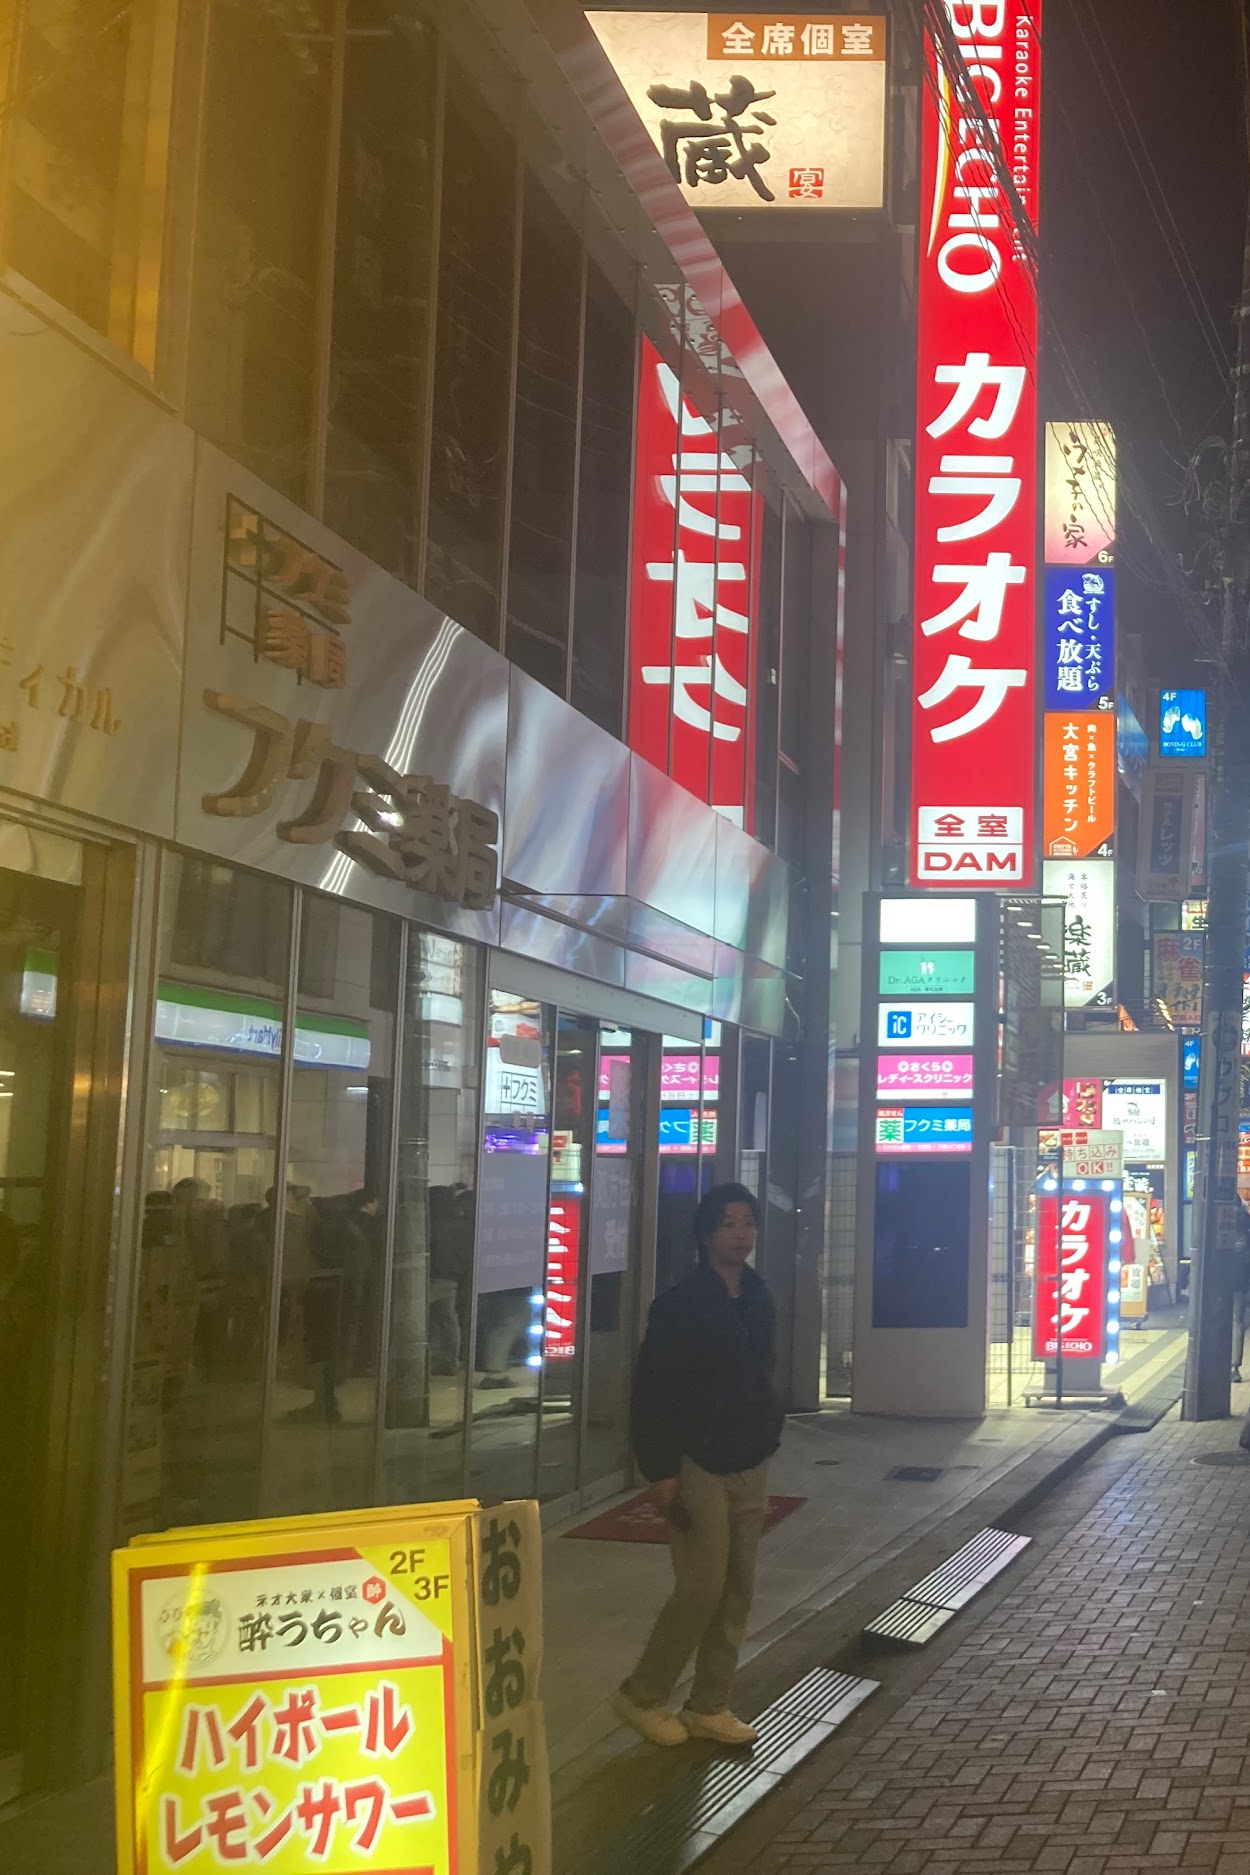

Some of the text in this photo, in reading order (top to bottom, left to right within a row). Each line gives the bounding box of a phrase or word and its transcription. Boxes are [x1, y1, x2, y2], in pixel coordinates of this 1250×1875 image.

[721, 22, 874, 56] 全席個室
[646, 75, 776, 202] 蔵
[1012, 16, 1033, 262] Karaoke Entertainent
[790, 168, 824, 199] 宴
[917, 352, 1028, 745] カラオケ
[1097, 550, 1114, 563] 6F
[1056, 588, 1084, 691] 食べ放題
[1085, 597, 1102, 691] すし・天ぷら
[1097, 696, 1114, 710] 5F
[1162, 692, 1177, 701] 4F
[1062, 722, 1079, 832] 大宮キッチン
[933, 813, 1009, 837] 全室
[923, 852, 1017, 872] DAM
[1097, 843, 1114, 857] 4F
[1183, 937, 1201, 951] 2F
[1096, 992, 1113, 1005] 3F
[916, 1013, 953, 1024] アイシー
[916, 1024, 967, 1036] クリニック
[909, 1061, 942, 1071] さくら
[877, 1073, 973, 1084] レディースクリニック
[878, 1119, 902, 1142] 薬
[904, 1118, 971, 1133] フクミ薬局
[1063, 1146, 1117, 1161] 持ち込み
[1050, 1200, 1092, 1333] カラオケ
[389, 1549, 426, 1576] 2F
[414, 1575, 449, 1601] 3F
[238, 1601, 407, 1652] 酔うちゃん
[181, 1686, 410, 1772] ハイボール
[164, 1780, 431, 1864] レモンサワー
